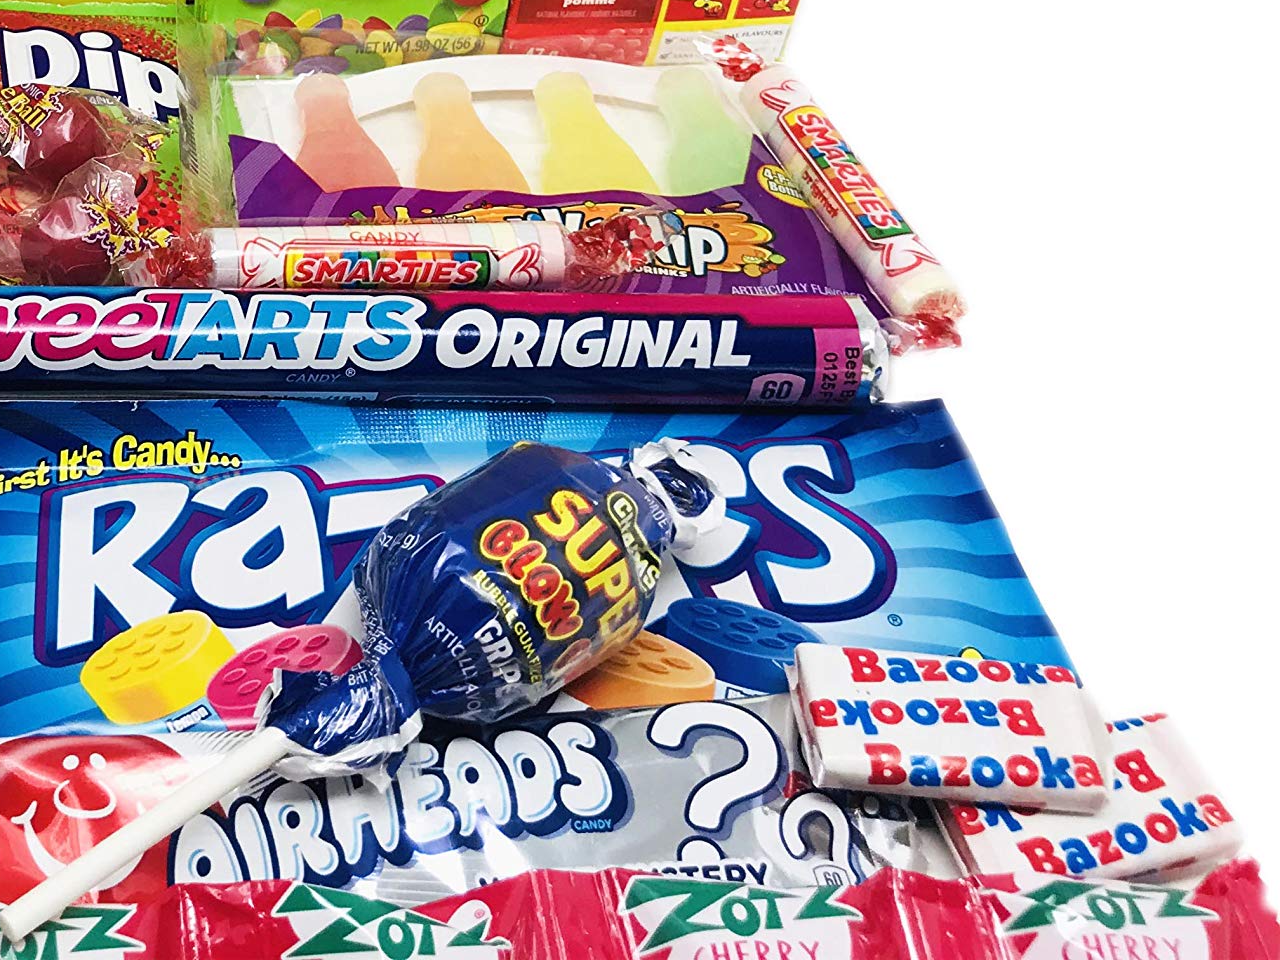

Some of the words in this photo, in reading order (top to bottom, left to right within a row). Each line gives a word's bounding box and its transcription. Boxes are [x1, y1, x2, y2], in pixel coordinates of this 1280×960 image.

[796, 111, 903, 230] SMARTIES
[349, 230, 421, 244] CANDY
[291, 255, 481, 287] SMARTIES
[632, 264, 689, 278] DRINKS
[730, 282, 808, 297] ARTIFICIALLY
[434, 308, 751, 369] ORIGINAL
[285, 372, 342, 385] CANDY
[843, 347, 860, 385] Best
[759, 379, 793, 400] 60
[57, 443, 105, 488] It's
[111, 430, 243, 477] Candy...
[480, 519, 584, 641] BLOW
[472, 569, 519, 626] BUBBLE
[513, 622, 538, 661] GUM
[841, 646, 1078, 688] Bazooka
[809, 696, 1046, 737] Bazooka
[863, 741, 1105, 790] Bazooka
[573, 818, 612, 832] CANDY
[1017, 792, 1236, 877] Bazooka
